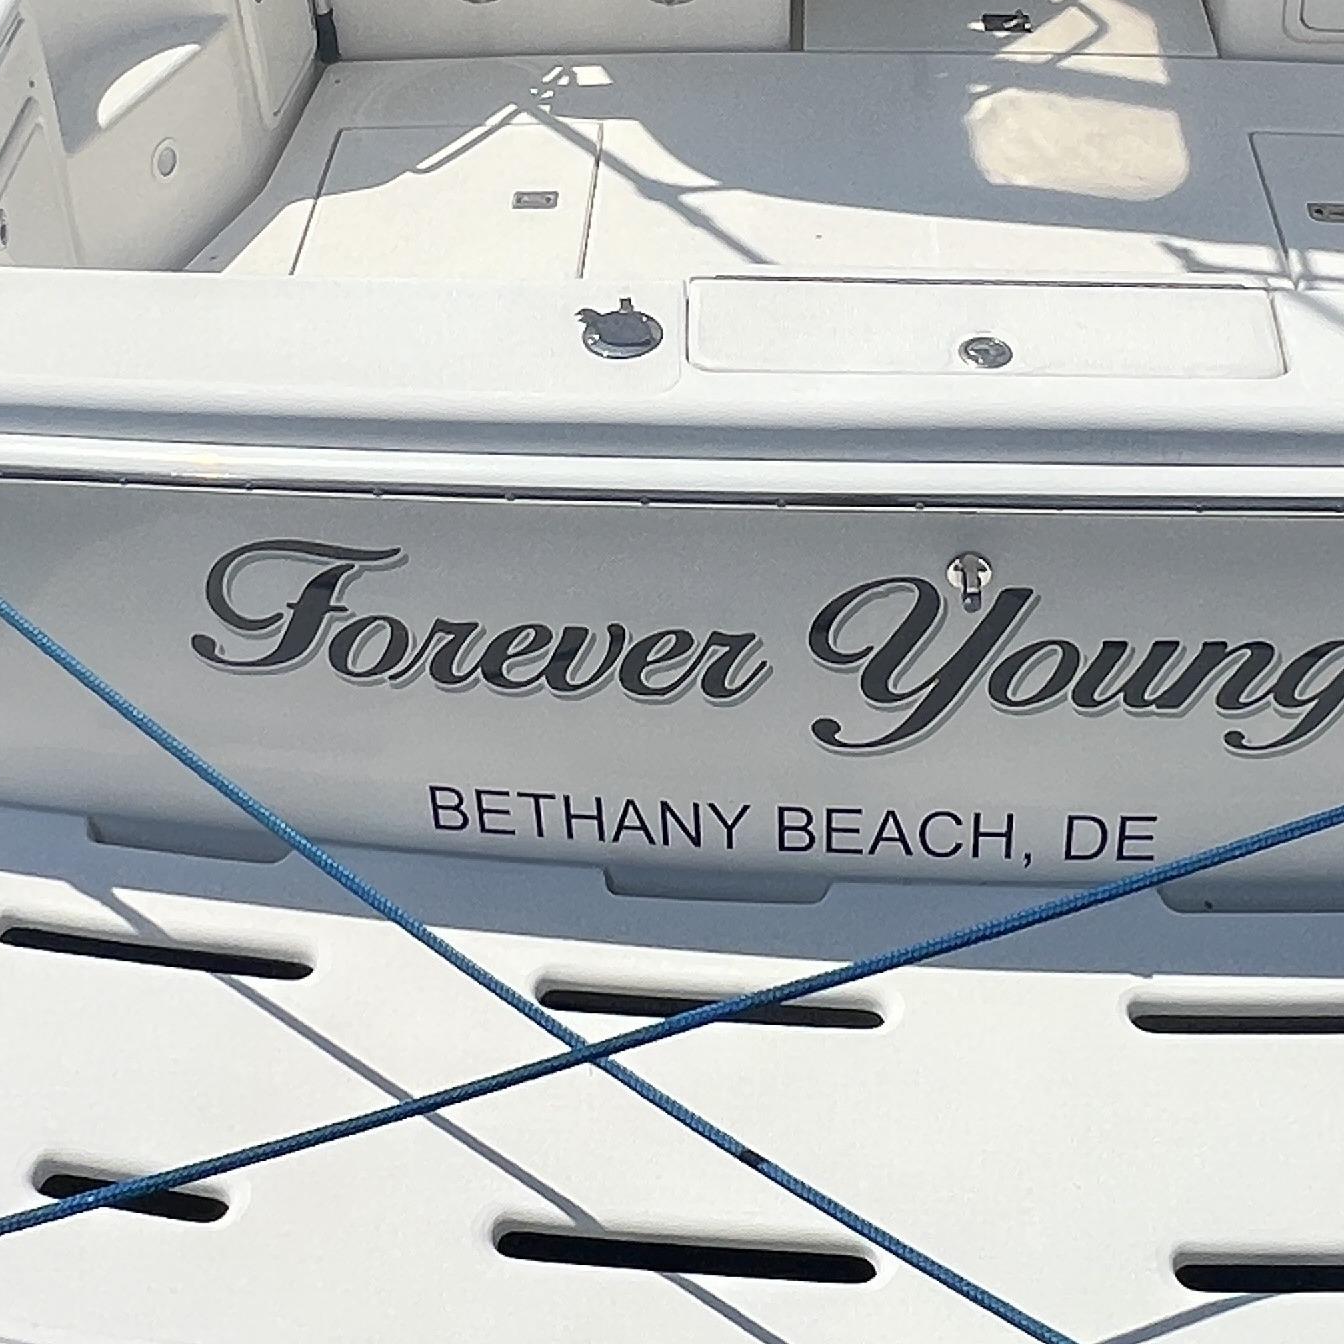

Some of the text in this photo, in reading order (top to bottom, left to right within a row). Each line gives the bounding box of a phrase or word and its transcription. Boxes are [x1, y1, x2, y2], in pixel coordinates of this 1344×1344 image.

[190, 544, 772, 702] Forever
[429, 785, 1159, 870] BETHANY BEACH, DE
